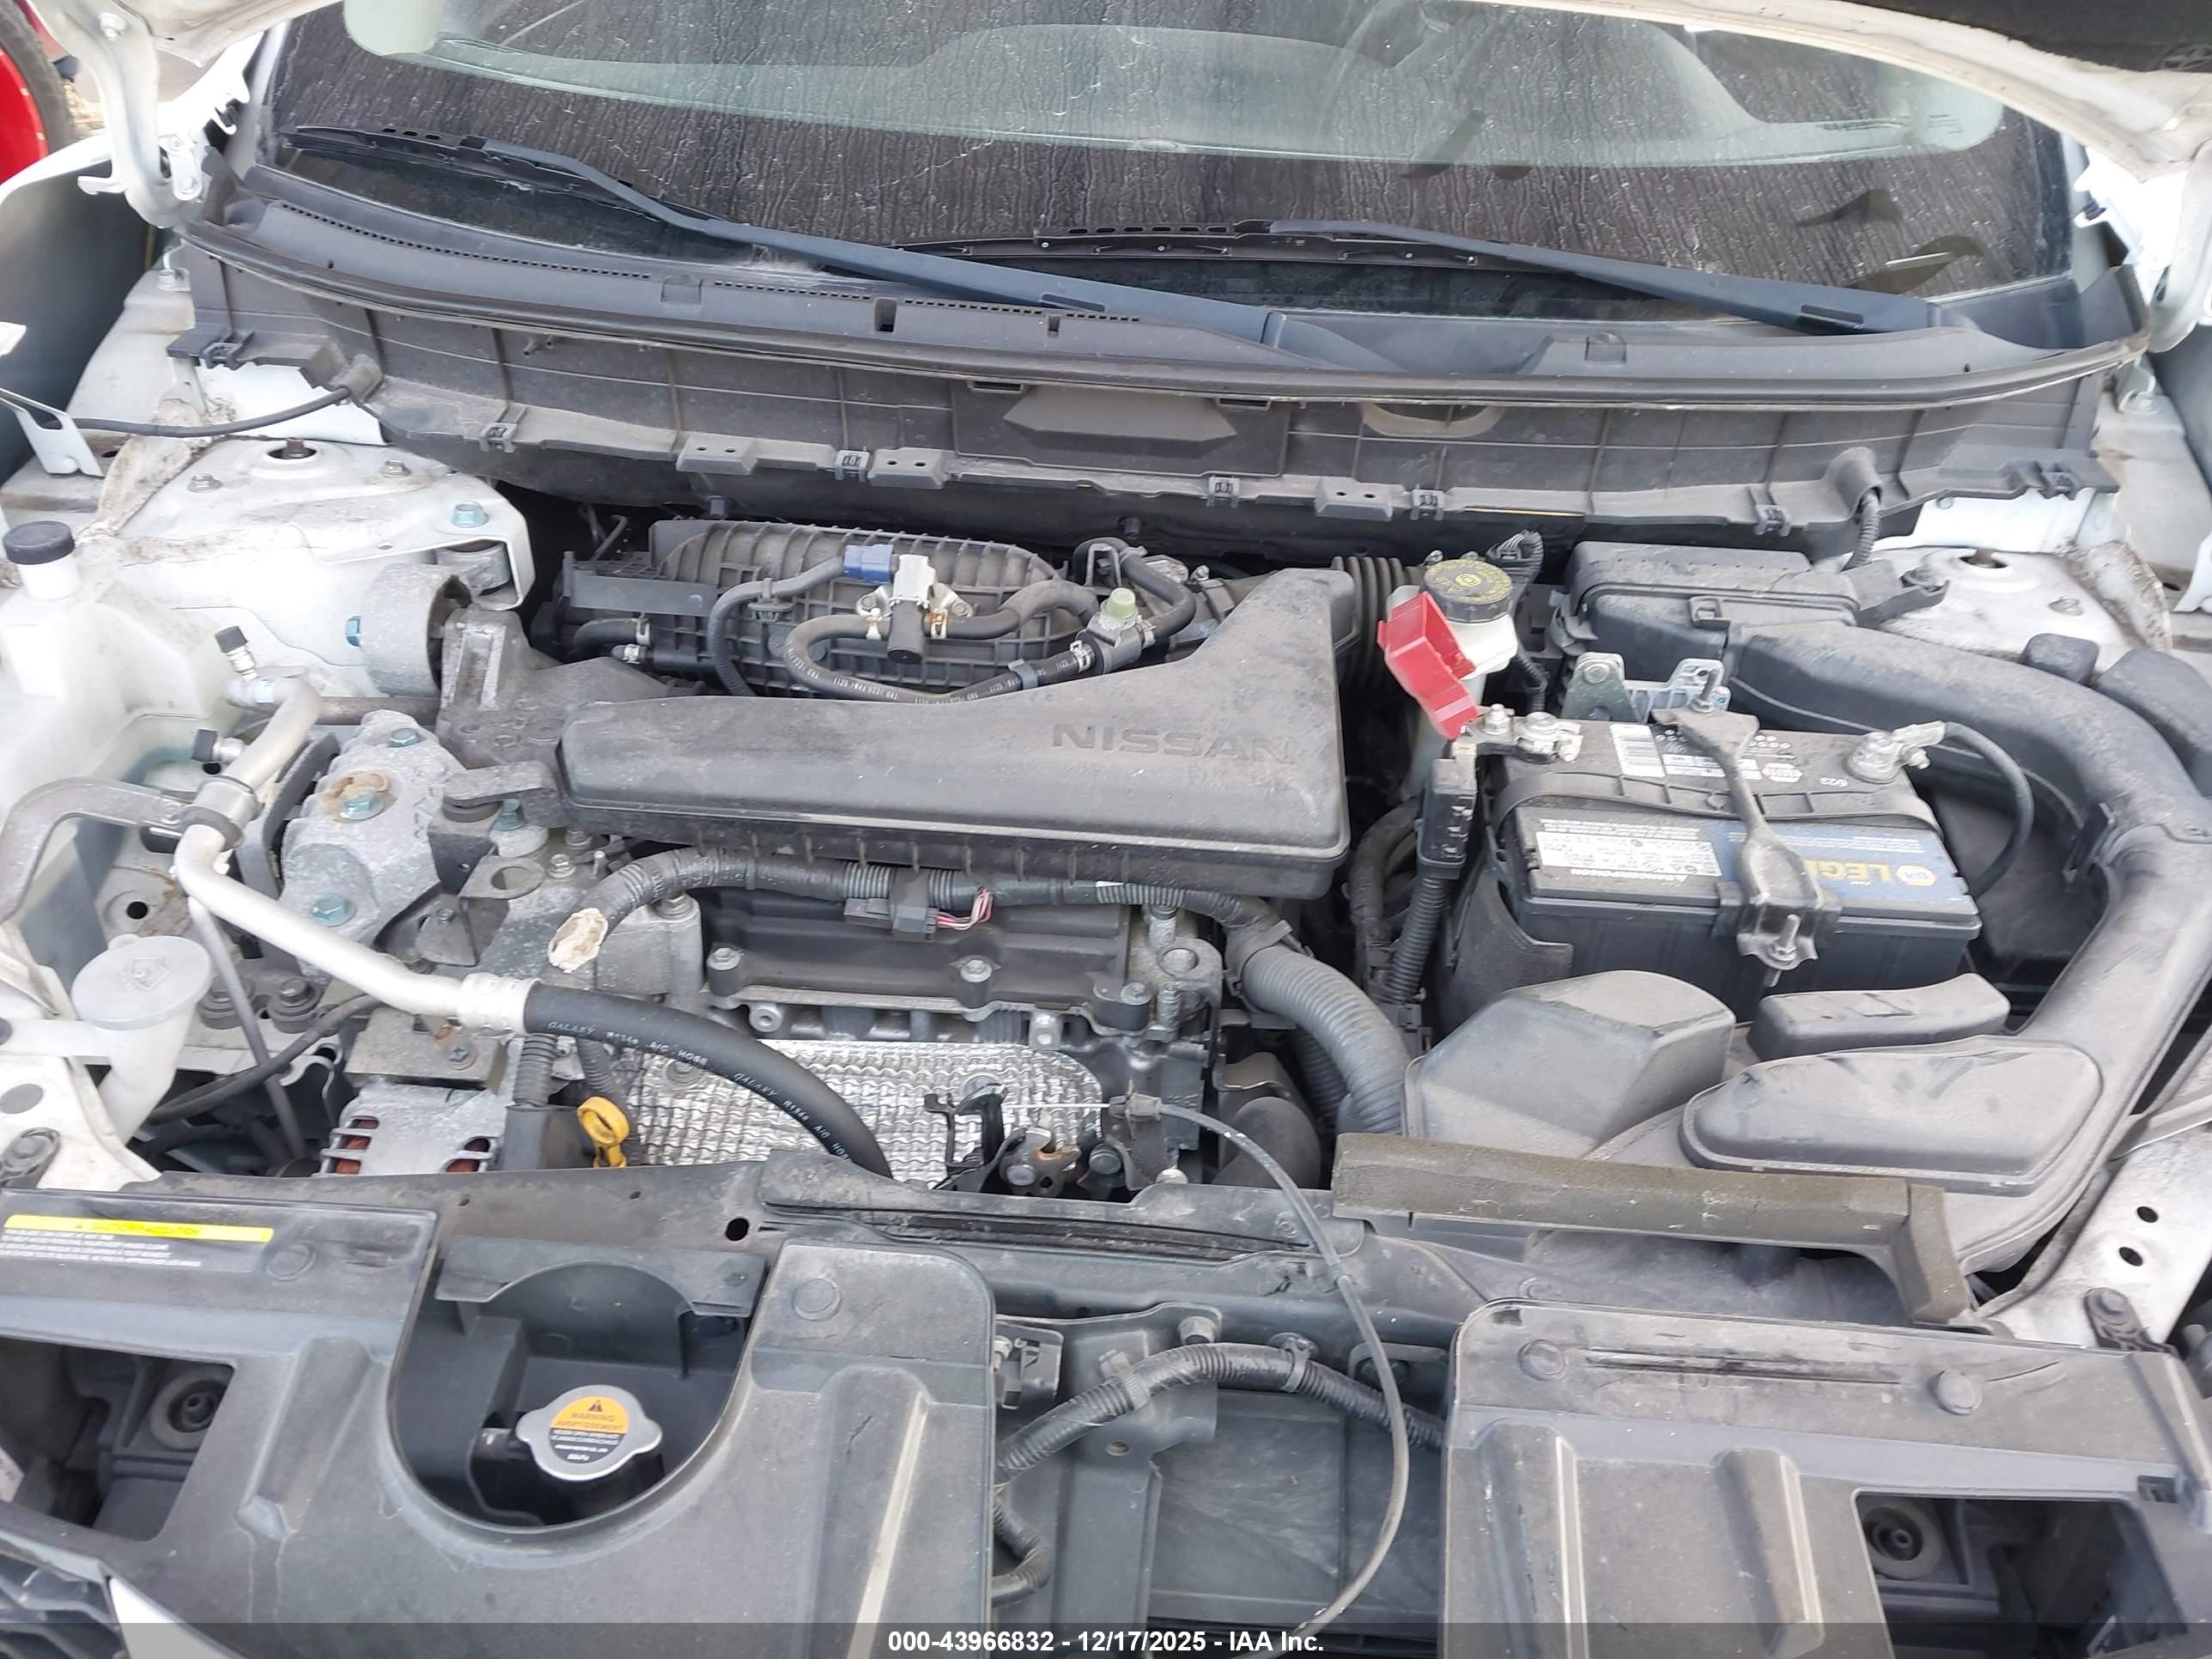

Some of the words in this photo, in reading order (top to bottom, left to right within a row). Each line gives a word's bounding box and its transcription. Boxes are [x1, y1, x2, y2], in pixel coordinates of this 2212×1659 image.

[1051, 723, 1297, 765] NISSAN
[547, 1021, 597, 1035] GALAXY
[732, 1073, 779, 1097] GALAXY
